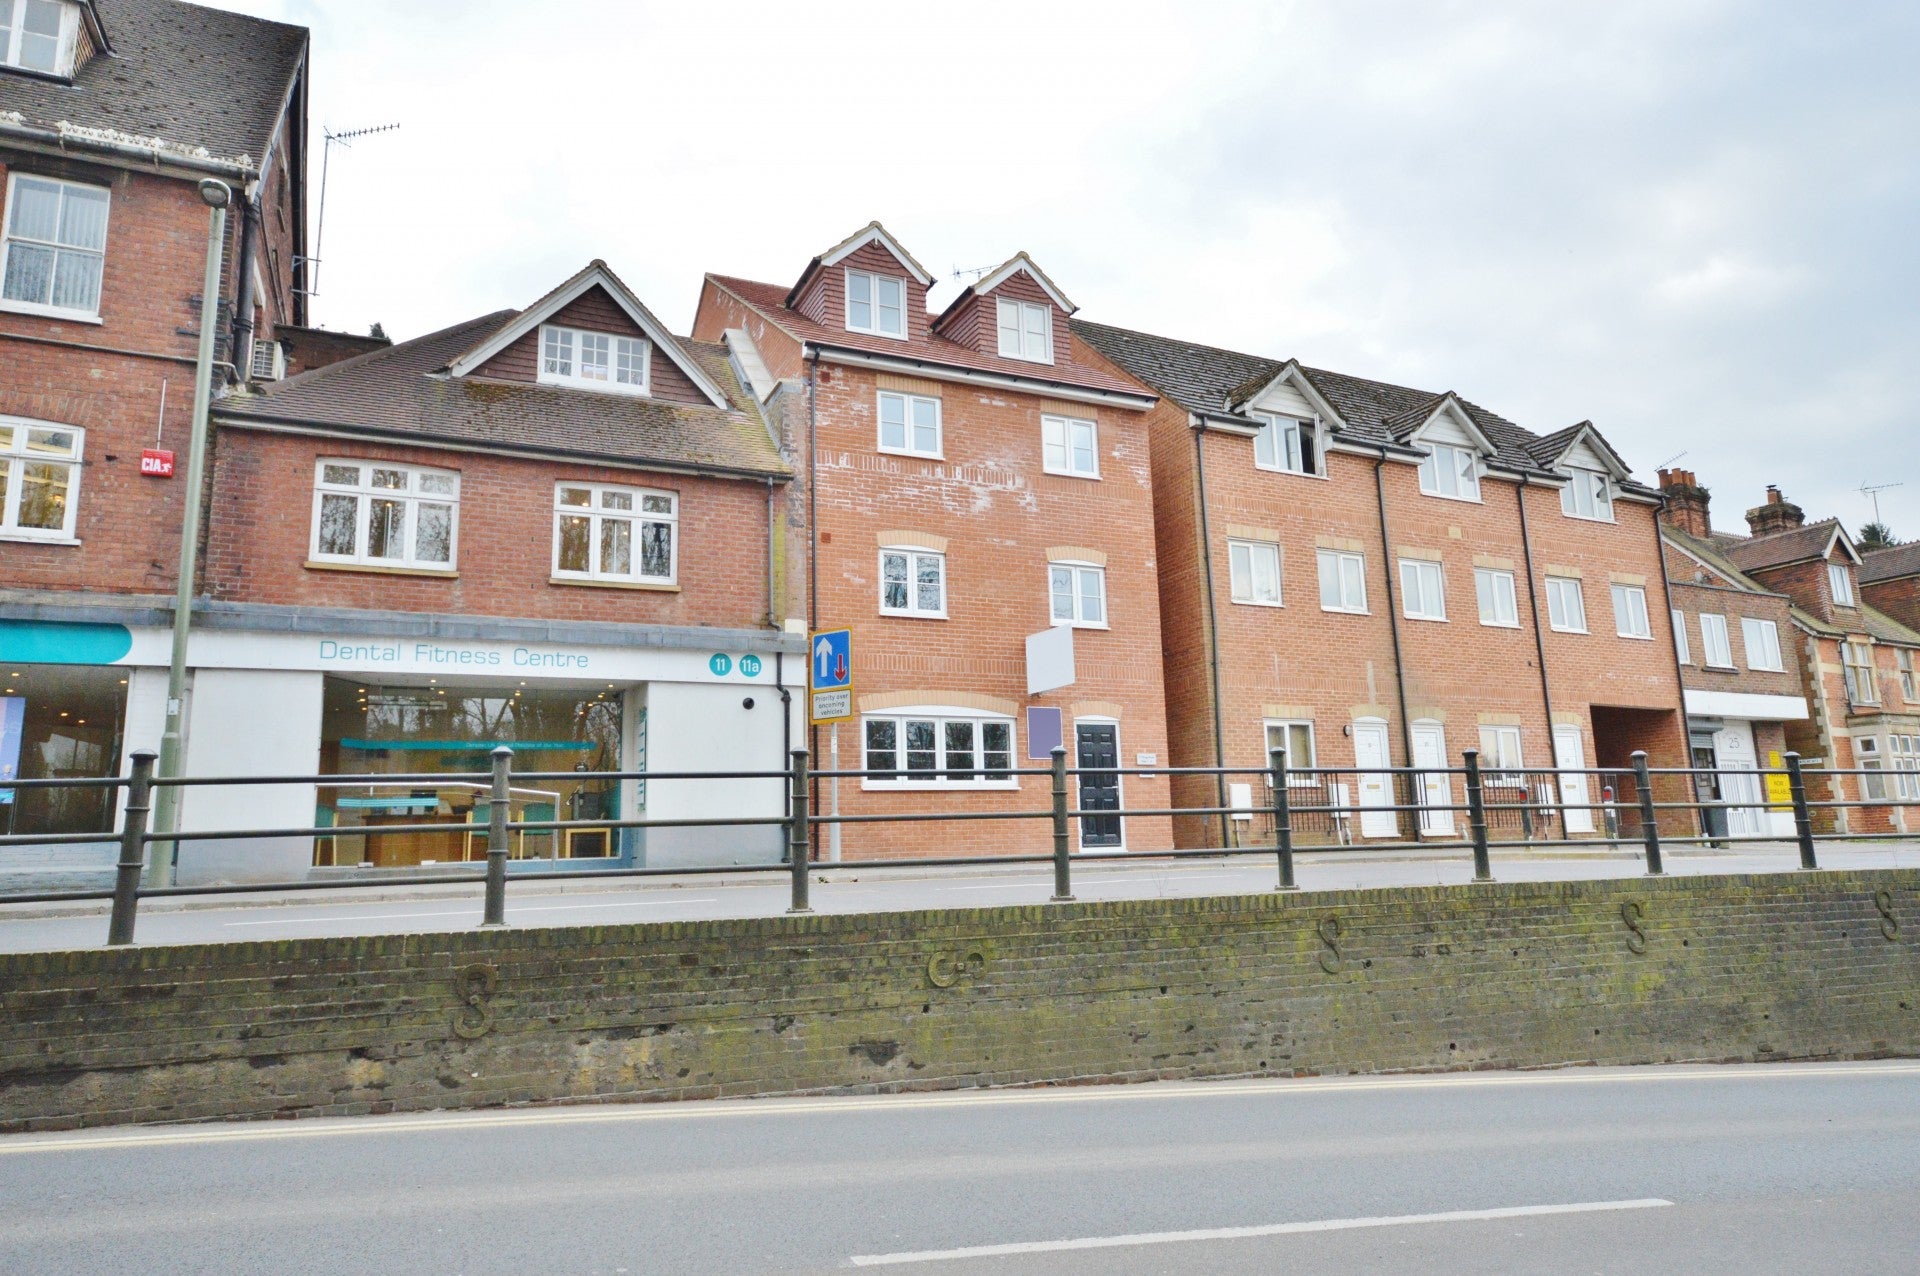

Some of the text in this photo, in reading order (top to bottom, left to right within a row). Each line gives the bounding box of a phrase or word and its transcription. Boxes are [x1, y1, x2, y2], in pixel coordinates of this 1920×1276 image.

[141, 457, 161, 472] CIA
[320, 640, 589, 668] Dental Fitness Centre
[715, 658, 726, 671] 11
[741, 659, 759, 673] 11a
[815, 694, 835, 702] Priority
[818, 701, 845, 709] oncoming
[1729, 737, 1740, 749] 25
